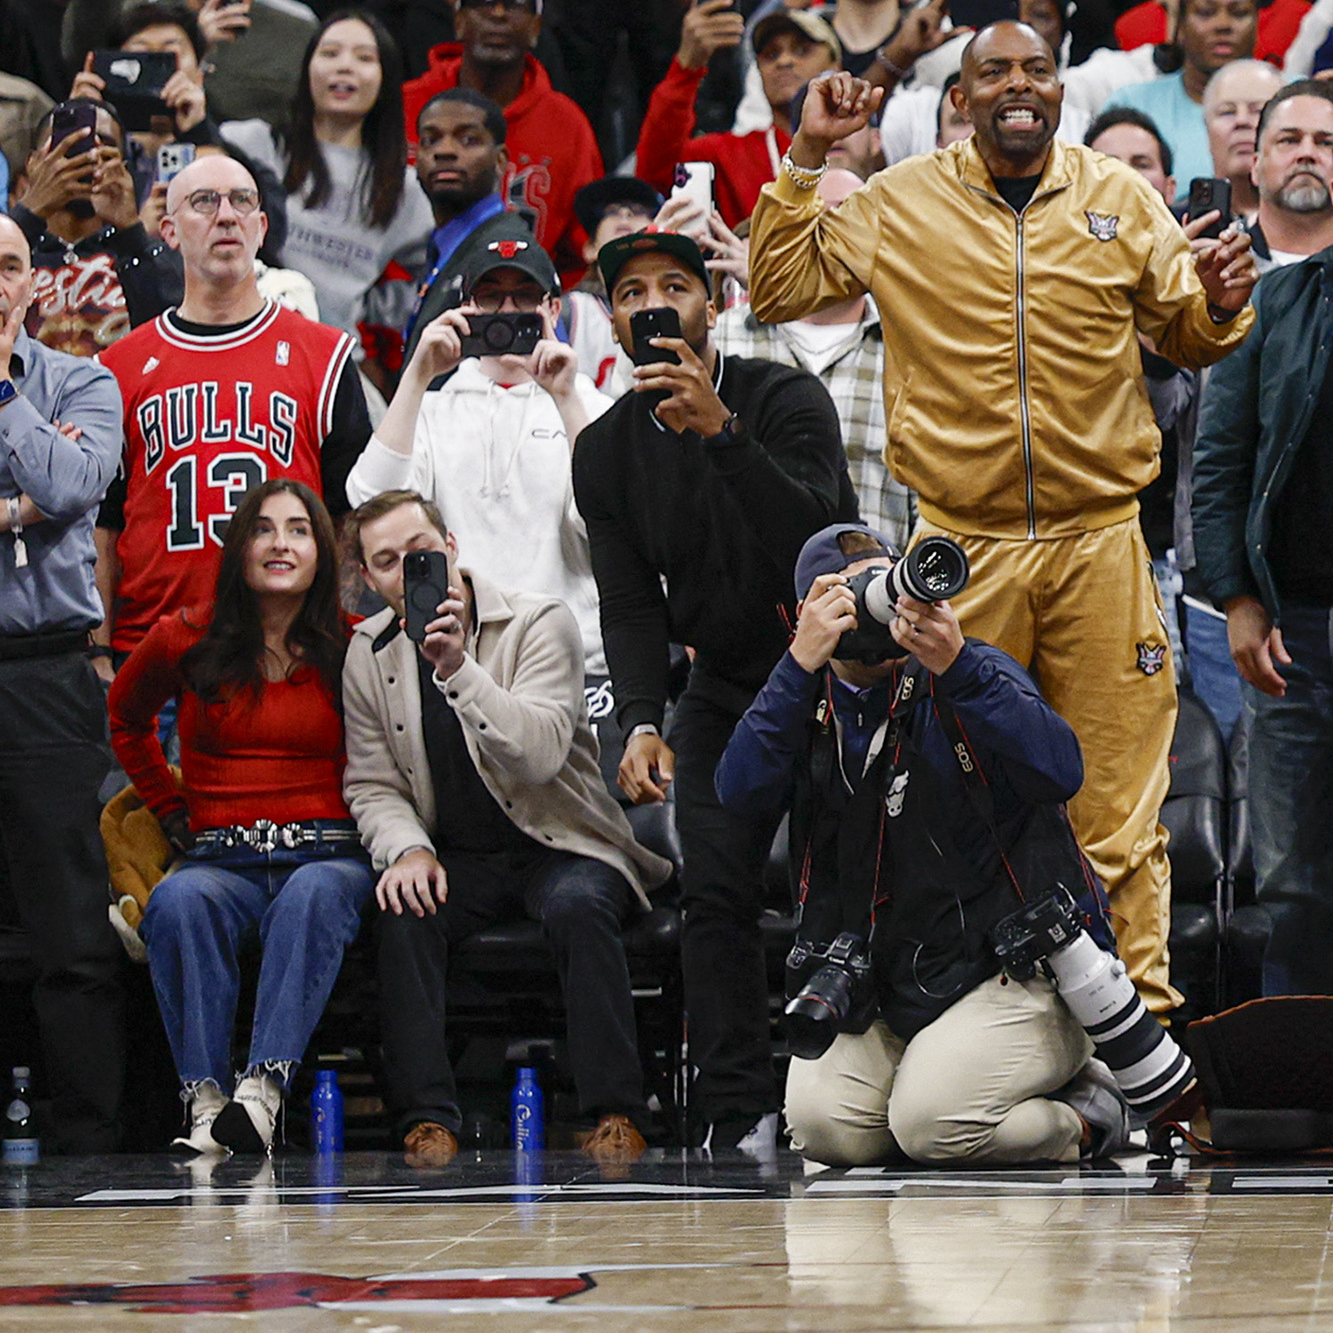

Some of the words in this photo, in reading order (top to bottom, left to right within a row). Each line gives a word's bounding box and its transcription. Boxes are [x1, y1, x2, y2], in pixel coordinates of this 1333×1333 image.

[137, 380, 298, 477] BULLS
[165, 452, 268, 552] 13
[901, 676, 915, 702] EOS
[954, 741, 974, 773] EOS
